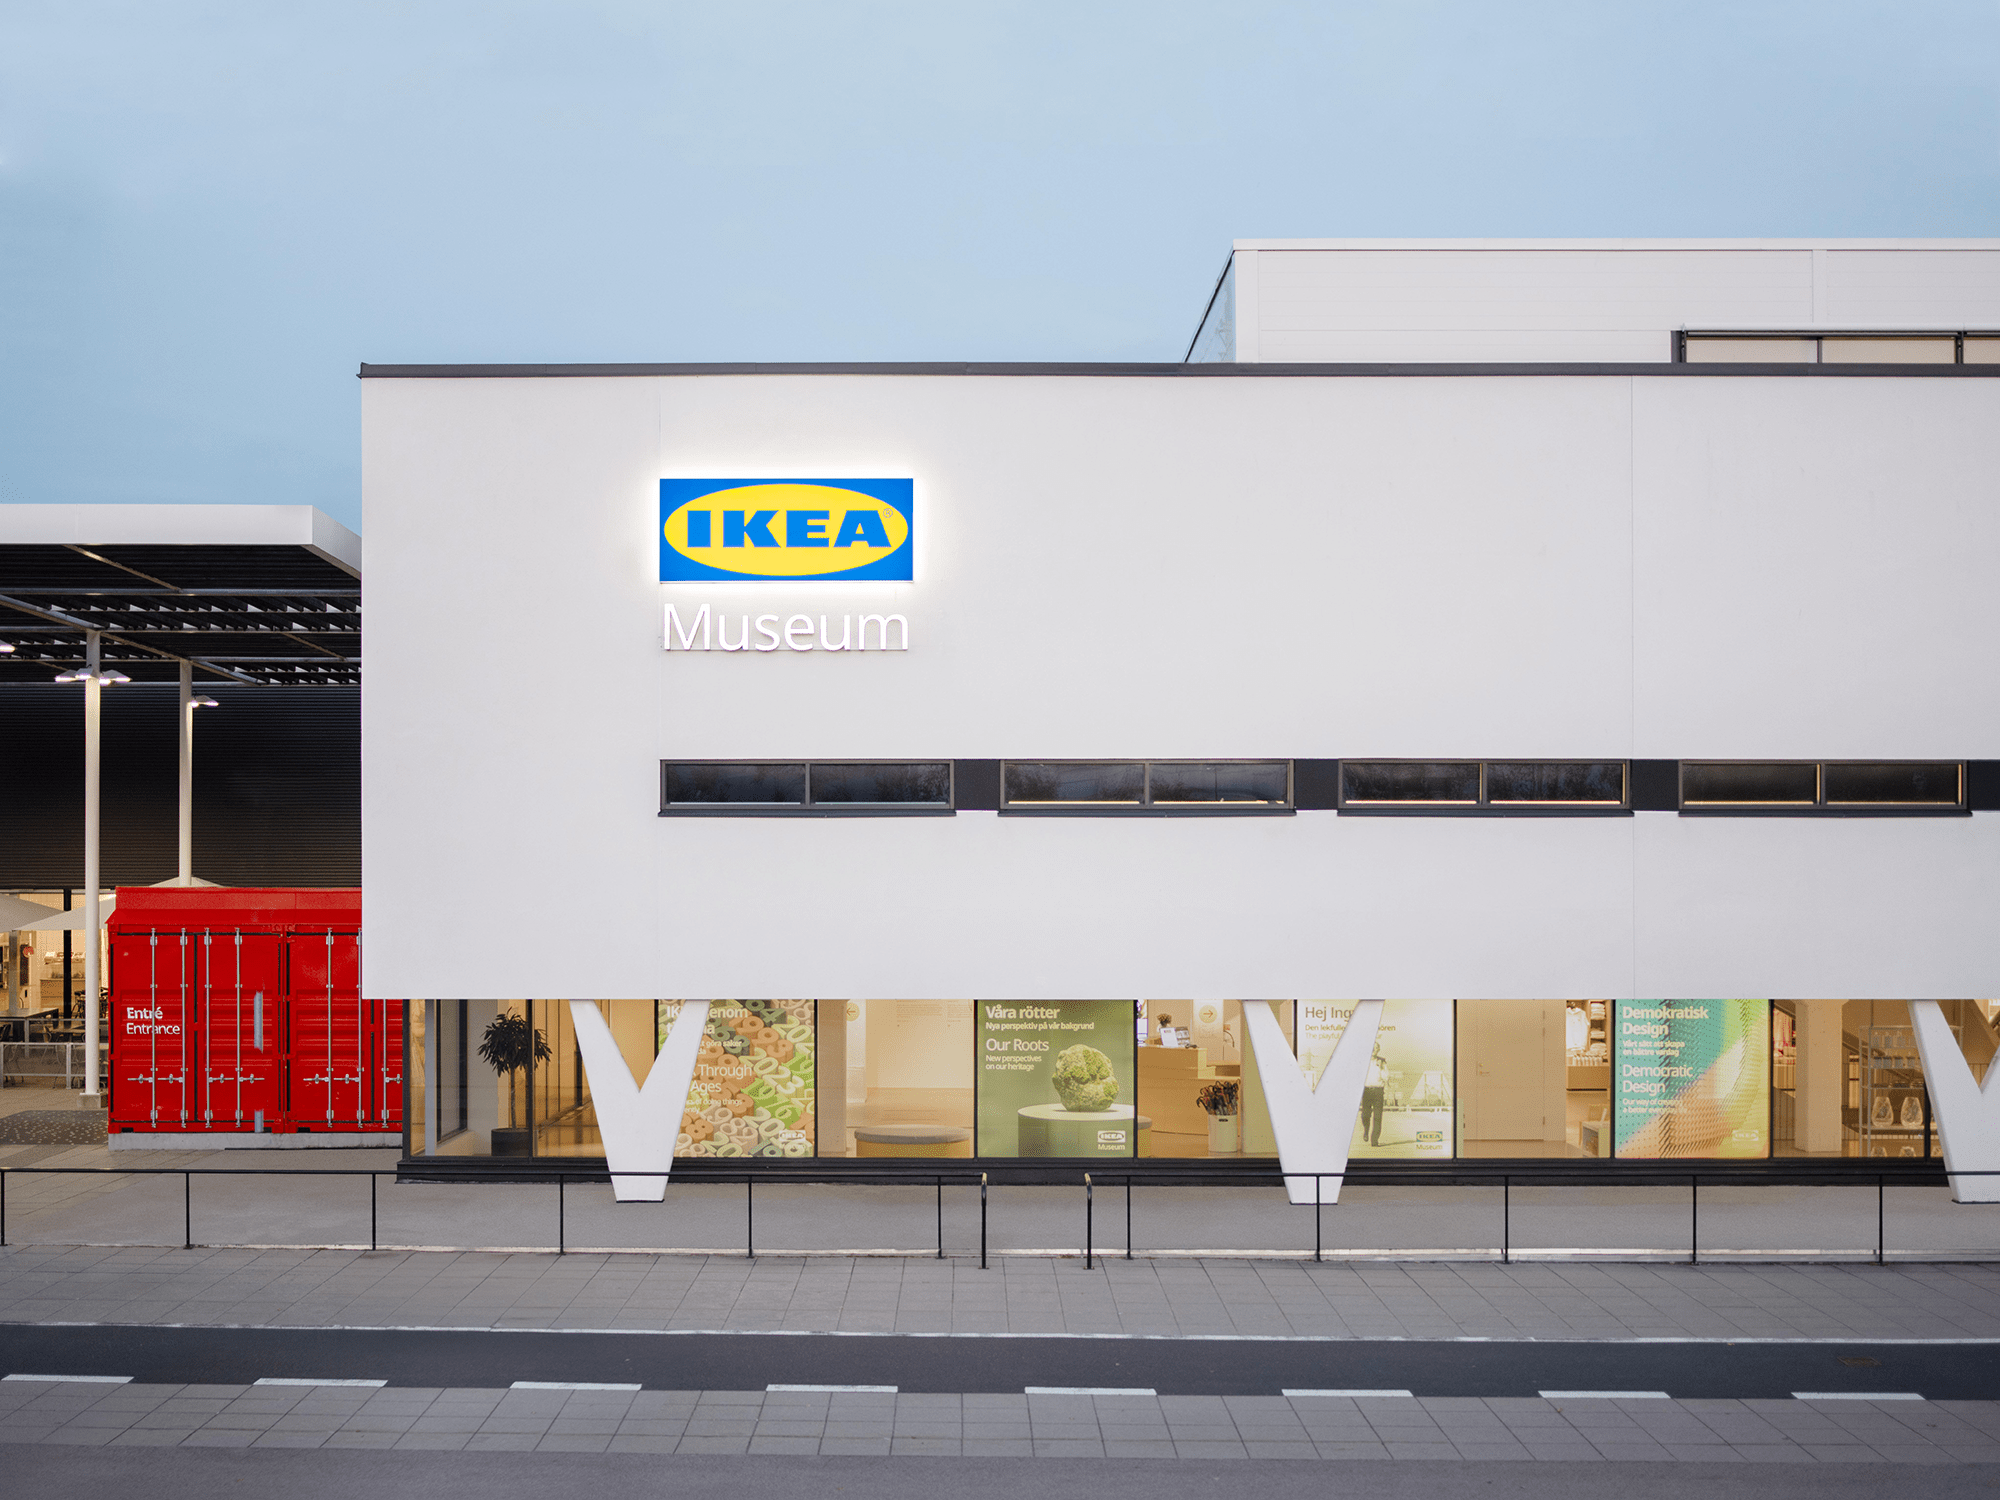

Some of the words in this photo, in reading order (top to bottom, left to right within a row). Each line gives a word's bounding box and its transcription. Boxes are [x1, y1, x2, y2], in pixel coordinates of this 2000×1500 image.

[687, 510, 892, 548] IKEA
[663, 603, 909, 652] Museum
[126, 1006, 163, 1019] Entré
[707, 1007, 748, 1021] enom
[985, 1004, 1017, 1019] Våra
[1019, 1006, 1060, 1019] rötter
[1305, 1006, 1326, 1022] Hej
[1331, 1006, 1354, 1022] Ing
[1623, 1006, 1709, 1019] Demokratisk
[126, 1022, 180, 1035] Entrance
[985, 1022, 1000, 1031] Nya
[1001, 1022, 1037, 1031] perspektiv
[1039, 1022, 1048, 1031] på
[1061, 1022, 1095, 1031] bakgrund
[1623, 1022, 1669, 1038] Design
[986, 1038, 1011, 1051] Our
[1013, 1038, 1050, 1051] Roots
[1002, 1055, 1042, 1063] perspectives
[697, 1064, 752, 1080] Through
[1008, 1063, 1035, 1071] heritage
[1623, 1064, 1694, 1077] Democratic
[690, 1080, 721, 1096] Ages
[1623, 1080, 1666, 1096] Design
